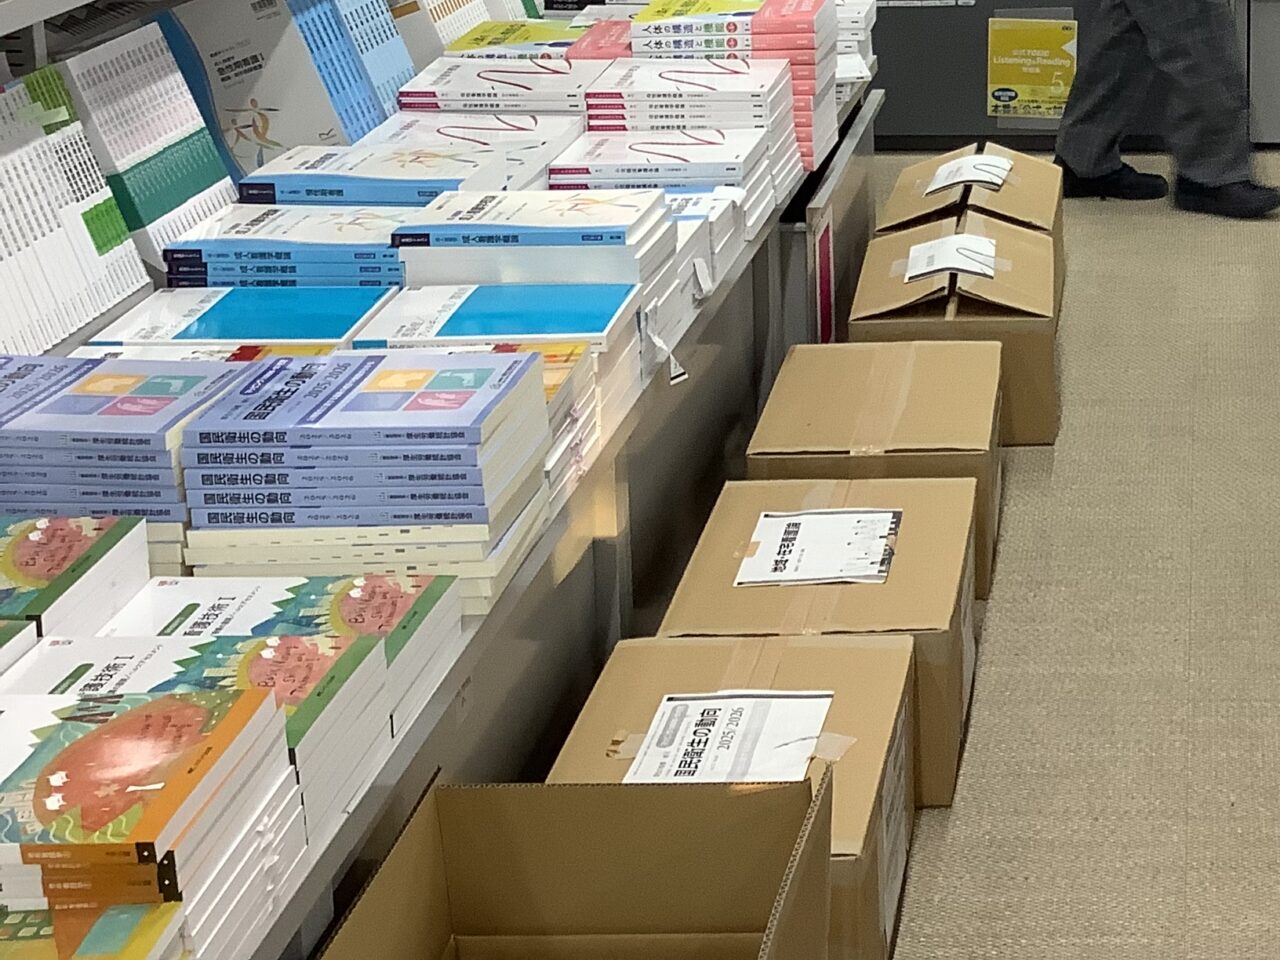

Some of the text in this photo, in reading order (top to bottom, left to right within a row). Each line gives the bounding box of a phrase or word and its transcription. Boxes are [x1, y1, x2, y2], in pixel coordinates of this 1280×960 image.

[641, 23, 725, 34] 人体の構造と機能
[642, 38, 726, 49] 人体の構造と機能
[1051, 71, 1065, 94] 5
[198, 430, 288, 446] 国民衛生の動向
[196, 450, 286, 466] 国民衛生の動向
[200, 470, 291, 487] 国民衛生の動向
[202, 490, 292, 506] 国民衛生の動向
[205, 510, 296, 526] 国民衛生の動向
[673, 707, 722, 778] 国民衛生の動向
